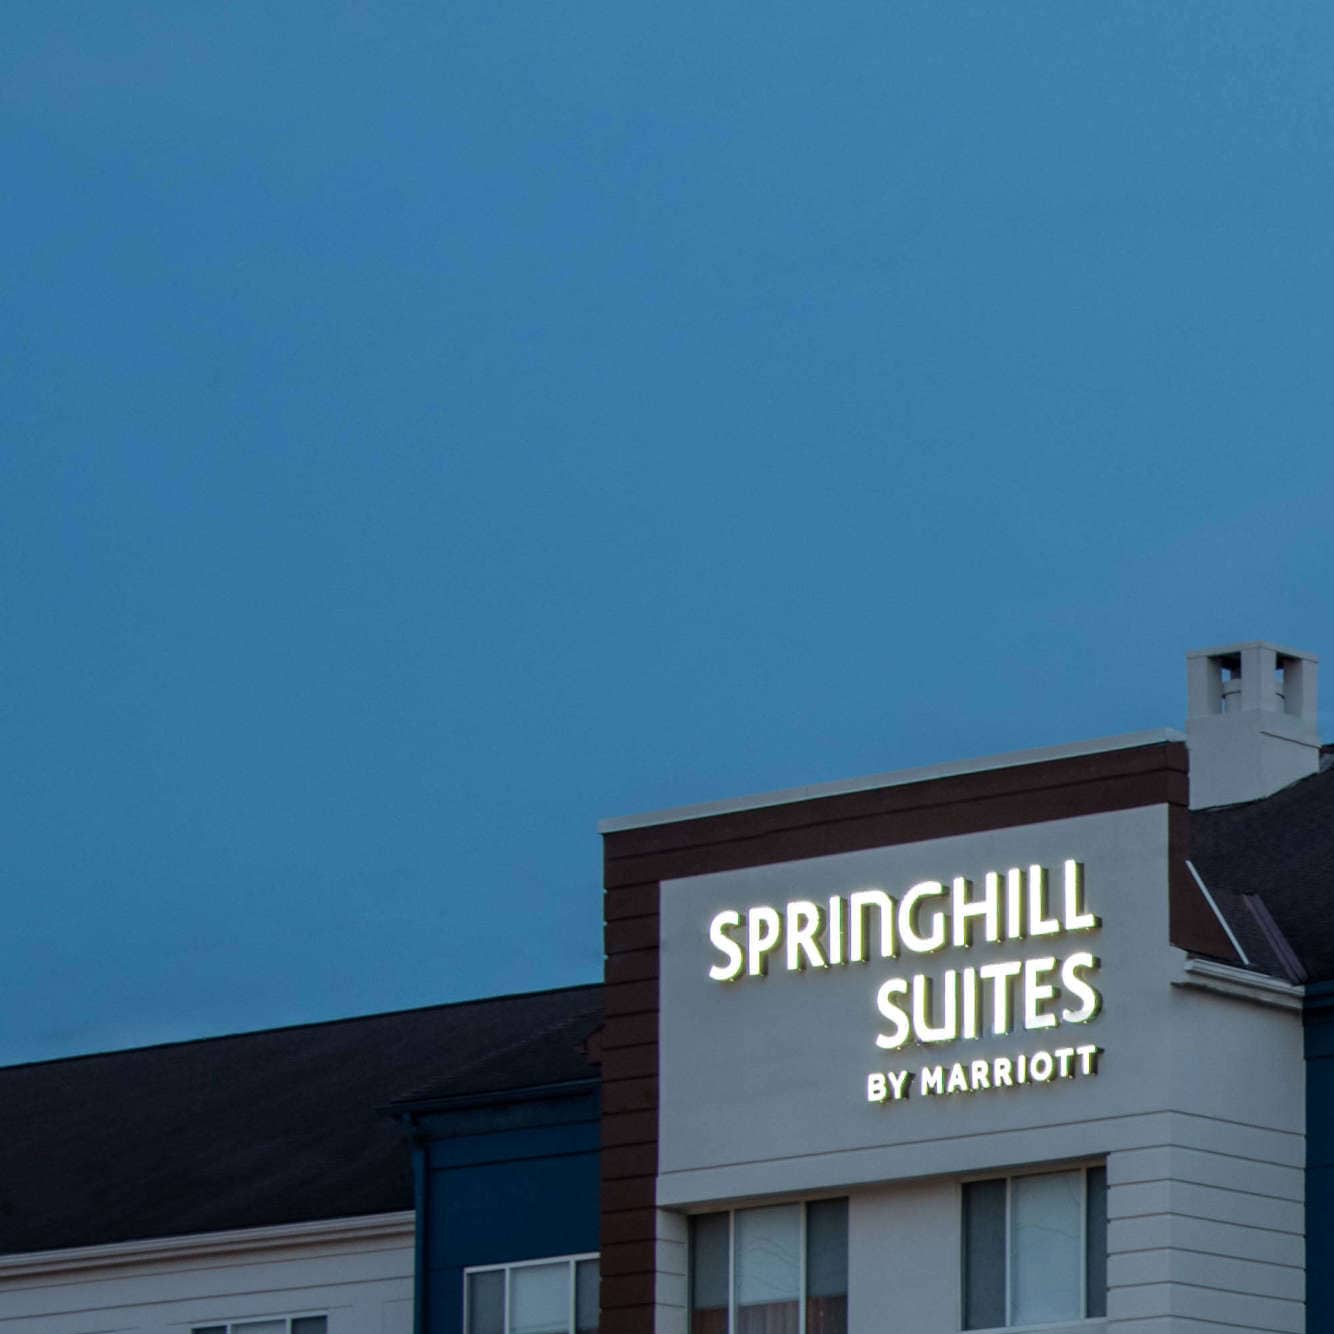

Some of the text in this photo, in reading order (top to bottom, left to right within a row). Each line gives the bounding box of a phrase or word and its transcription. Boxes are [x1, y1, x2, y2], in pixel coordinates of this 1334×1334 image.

[709, 859, 1099, 982] SPRINGHILL
[875, 952, 1100, 1050] SUITES
[867, 1045, 1101, 1102] BY MARRIOTT
